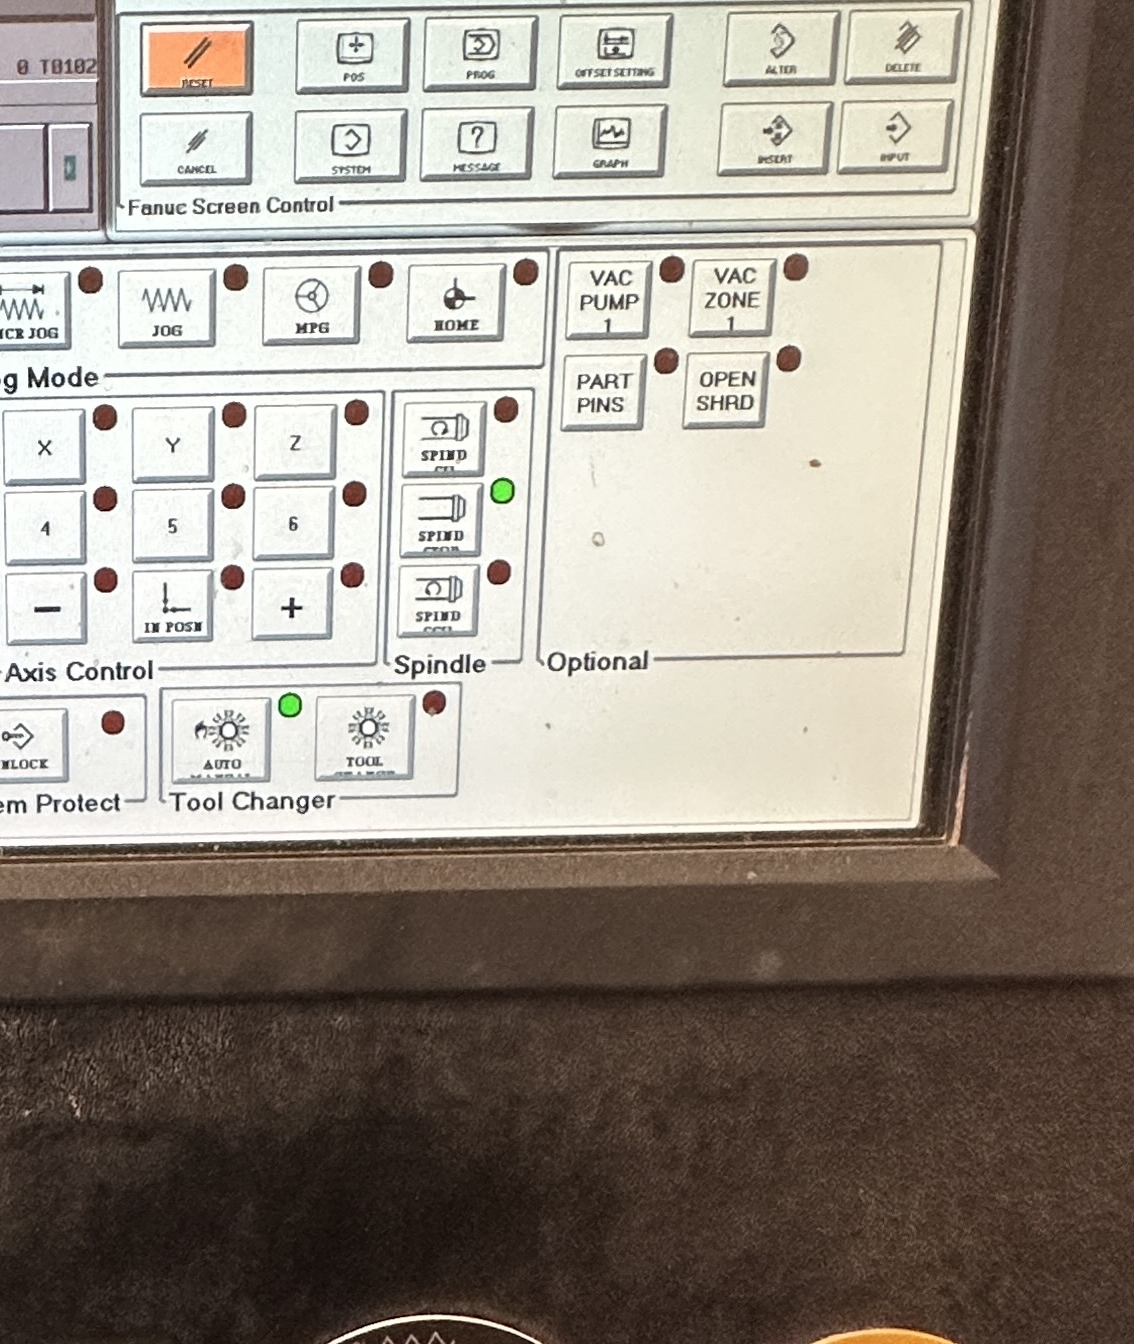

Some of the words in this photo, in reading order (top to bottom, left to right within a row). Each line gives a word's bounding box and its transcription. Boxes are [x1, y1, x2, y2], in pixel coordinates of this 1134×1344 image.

[128, 197, 187, 216] Fanuc
[192, 197, 261, 216] Screen
[266, 195, 335, 215] Control
[589, 268, 634, 287] VAC
[714, 267, 758, 285] VAC
[579, 293, 640, 311] PUMP
[704, 291, 762, 309] ZONE
[151, 324, 183, 338] JOG
[295, 321, 330, 335] MPG
[27, 366, 99, 390] Mode
[577, 372, 634, 391] PART
[699, 370, 757, 388] OPEN
[577, 397, 625, 414] PINS
[696, 394, 755, 412] SHRD
[5, 662, 57, 682] Axis
[66, 660, 154, 682] Control
[393, 654, 487, 679] Spindle
[547, 650, 650, 676] Optional
[203, 758, 242, 770] AUTO
[345, 756, 384, 767] TOOL
[36, 793, 122, 814] Protect
[169, 791, 223, 812] Tool
[231, 790, 337, 816] Changer
